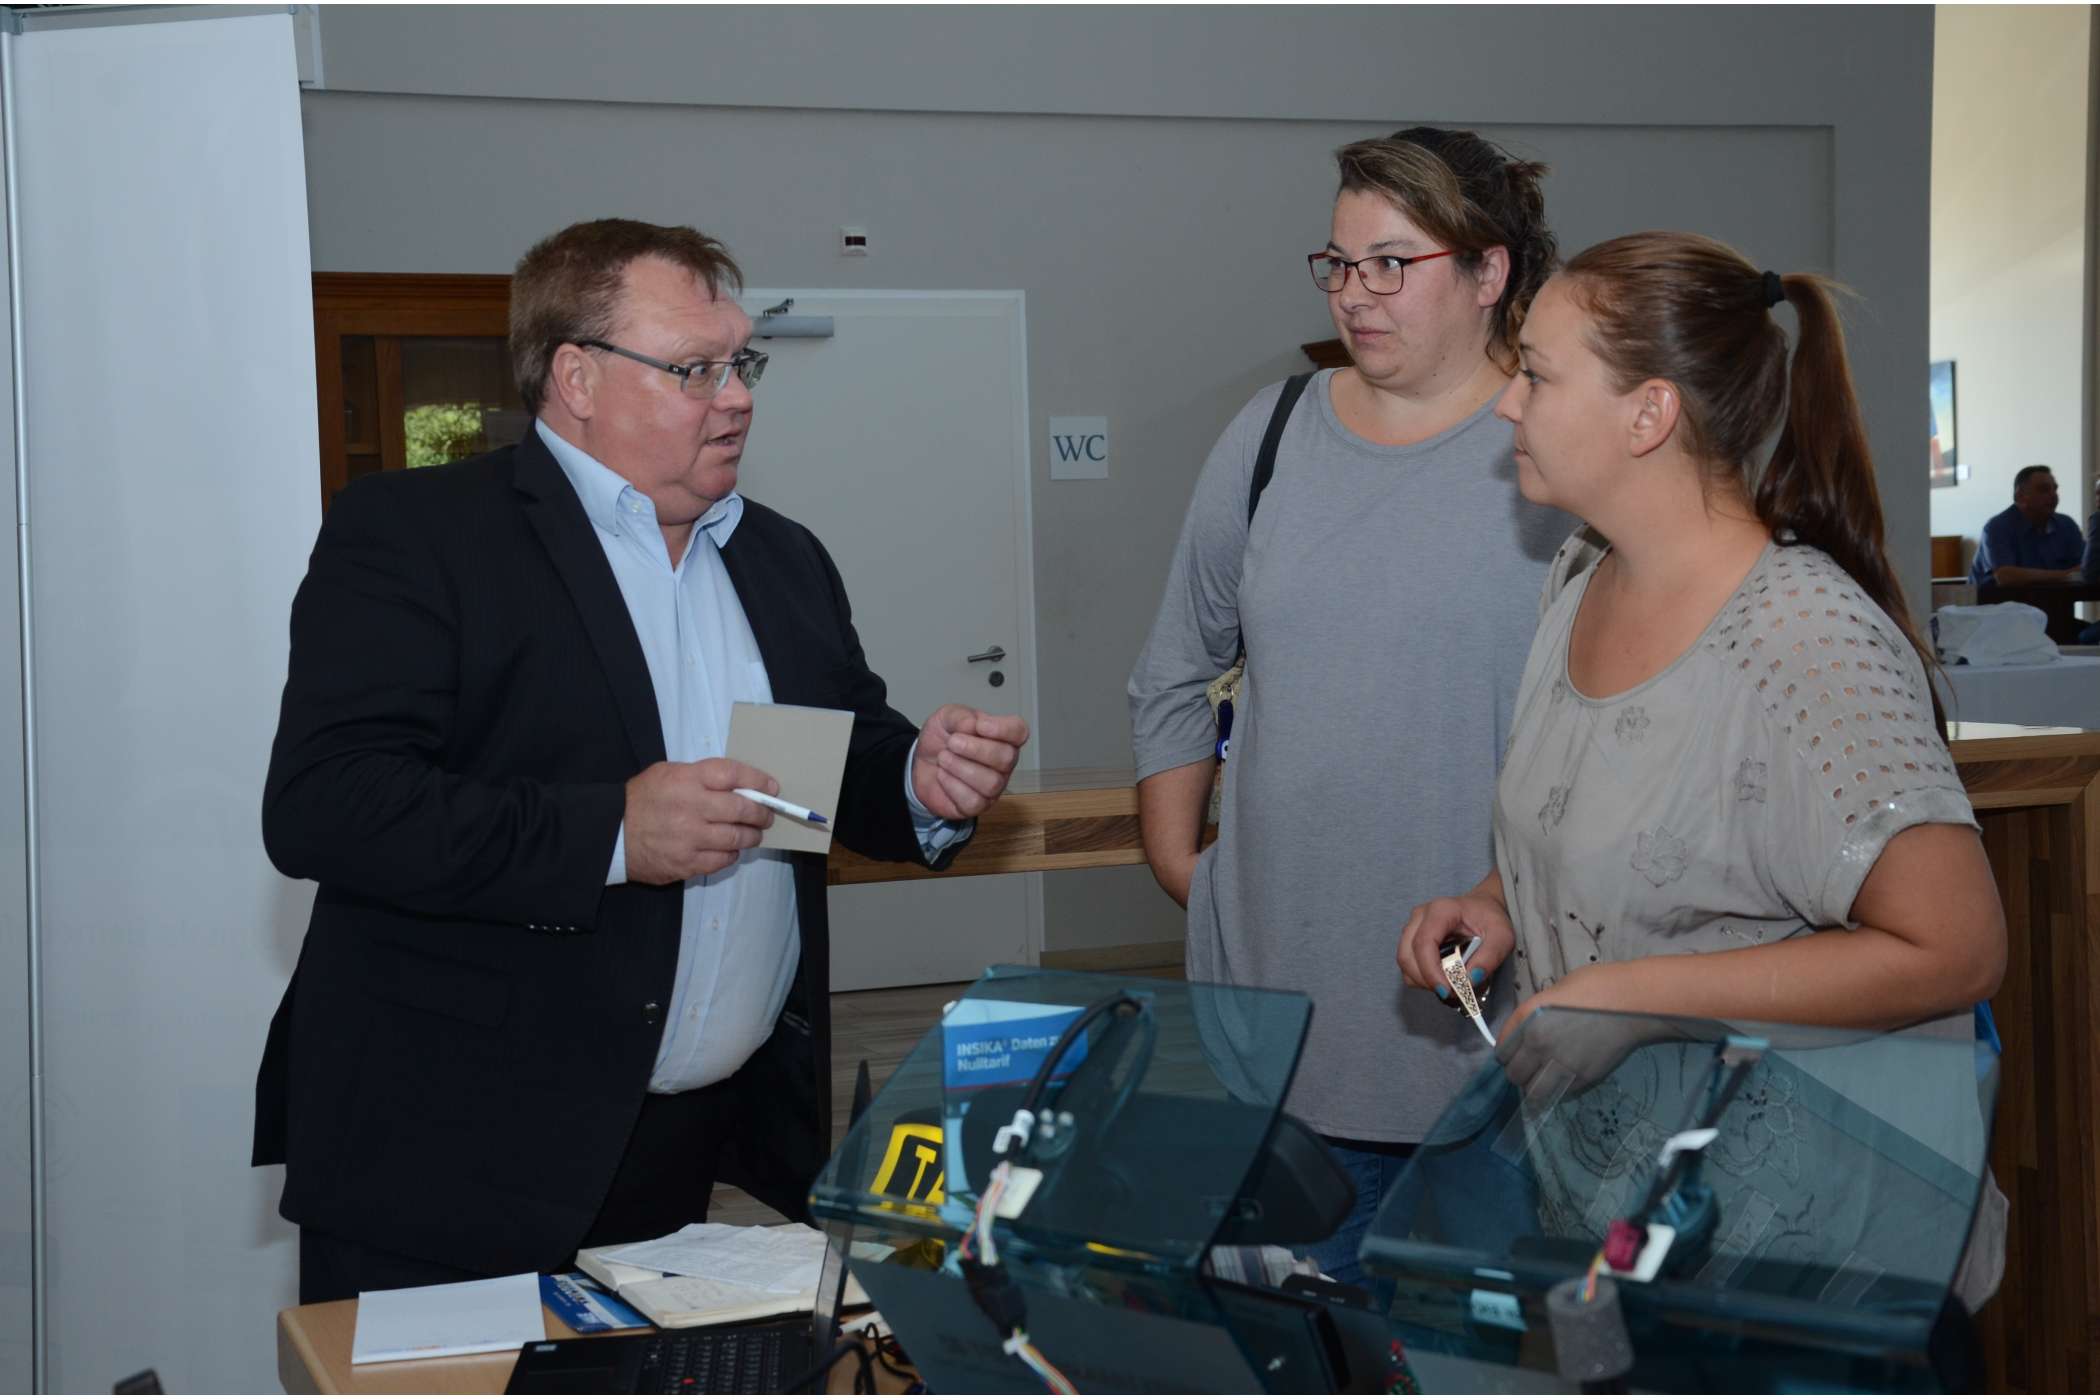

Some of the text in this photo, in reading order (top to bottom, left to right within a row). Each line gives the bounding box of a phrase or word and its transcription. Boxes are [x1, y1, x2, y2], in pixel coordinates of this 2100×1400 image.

[1052, 434, 1106, 462] WC
[1011, 1036, 1047, 1051] Daten
[957, 1054, 1011, 1073] Nulltarif
